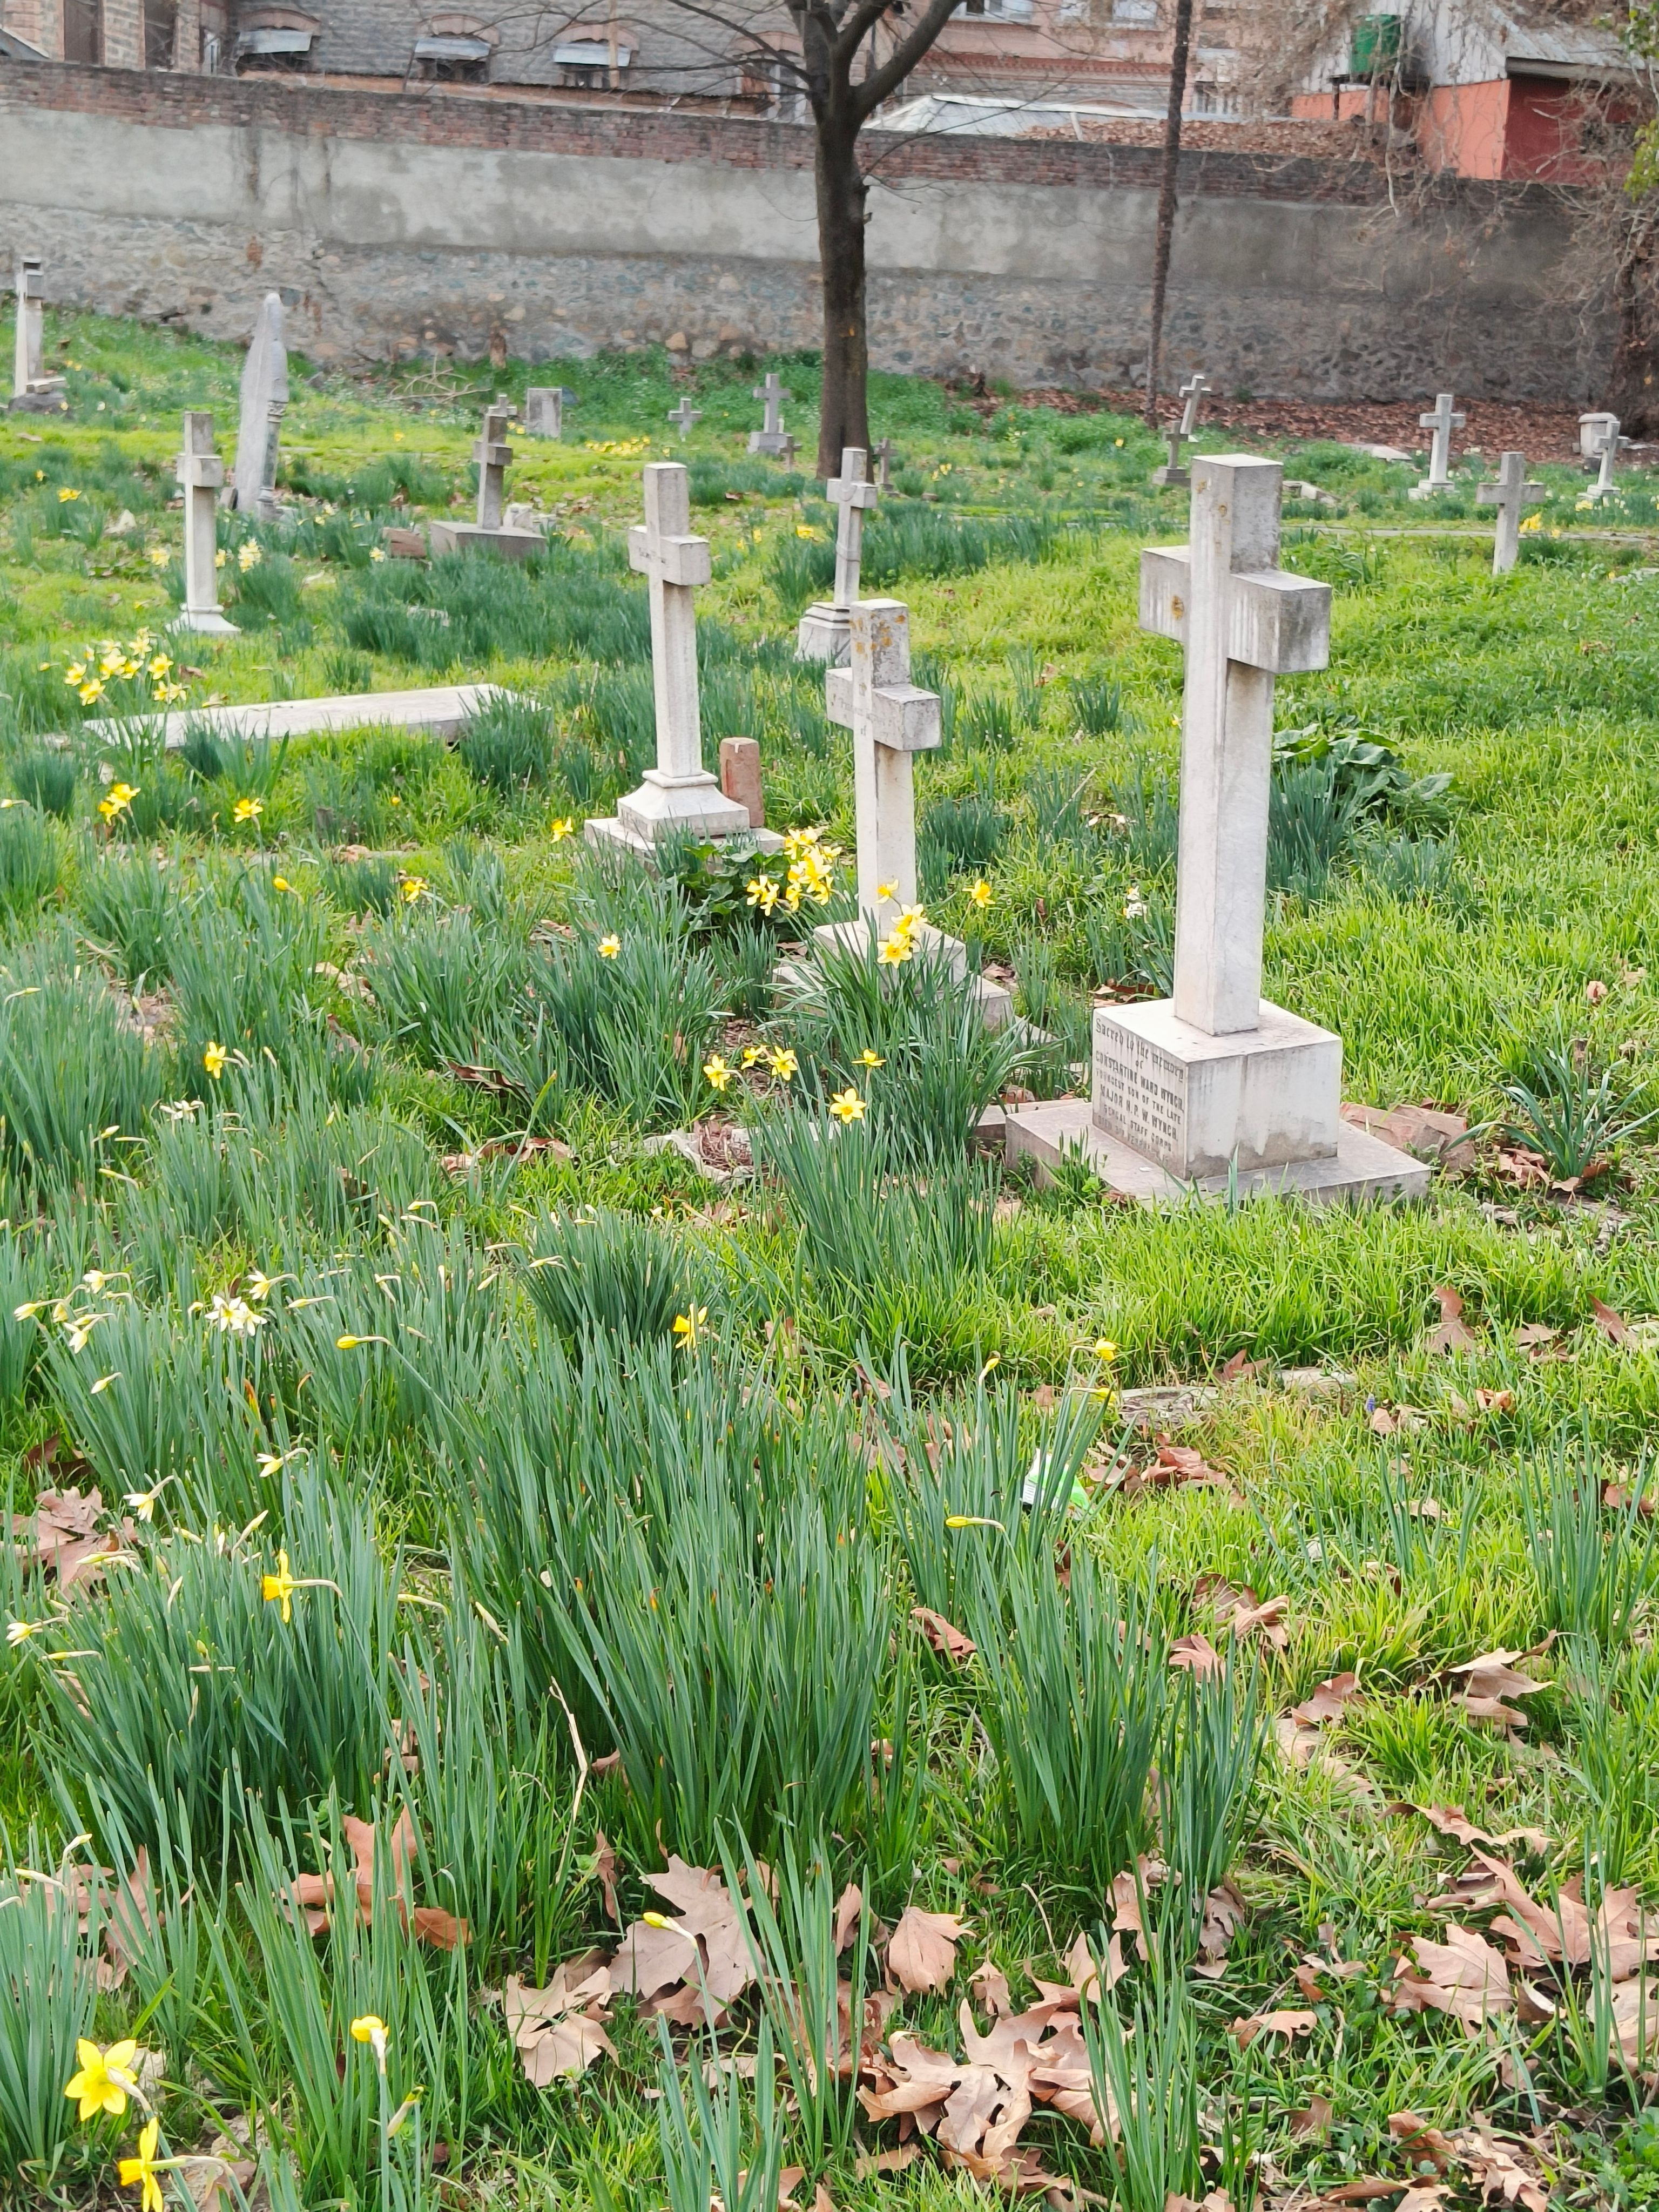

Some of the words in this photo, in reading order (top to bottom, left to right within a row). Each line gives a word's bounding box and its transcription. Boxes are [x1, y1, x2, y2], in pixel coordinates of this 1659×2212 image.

[1096, 1018, 1123, 1045] Sacred
[1127, 1034, 1134, 1051] to
[1137, 1040, 1149, 1059] the
[1152, 1053, 1184, 1083] memory
[1135, 1060, 1144, 1069] of
[1096, 1050, 1137, 1084] CONSTANTINE
[1141, 1075, 1158, 1096] WARD
[1101, 1083, 1123, 1108] MAJOR
[1128, 1086, 1138, 1100] SON
[1142, 1094, 1149, 1105] OF
[1152, 1100, 1163, 1114] THE
[1166, 1108, 1181, 1124] LATE
[1130, 1120, 1148, 1137] STAFF
